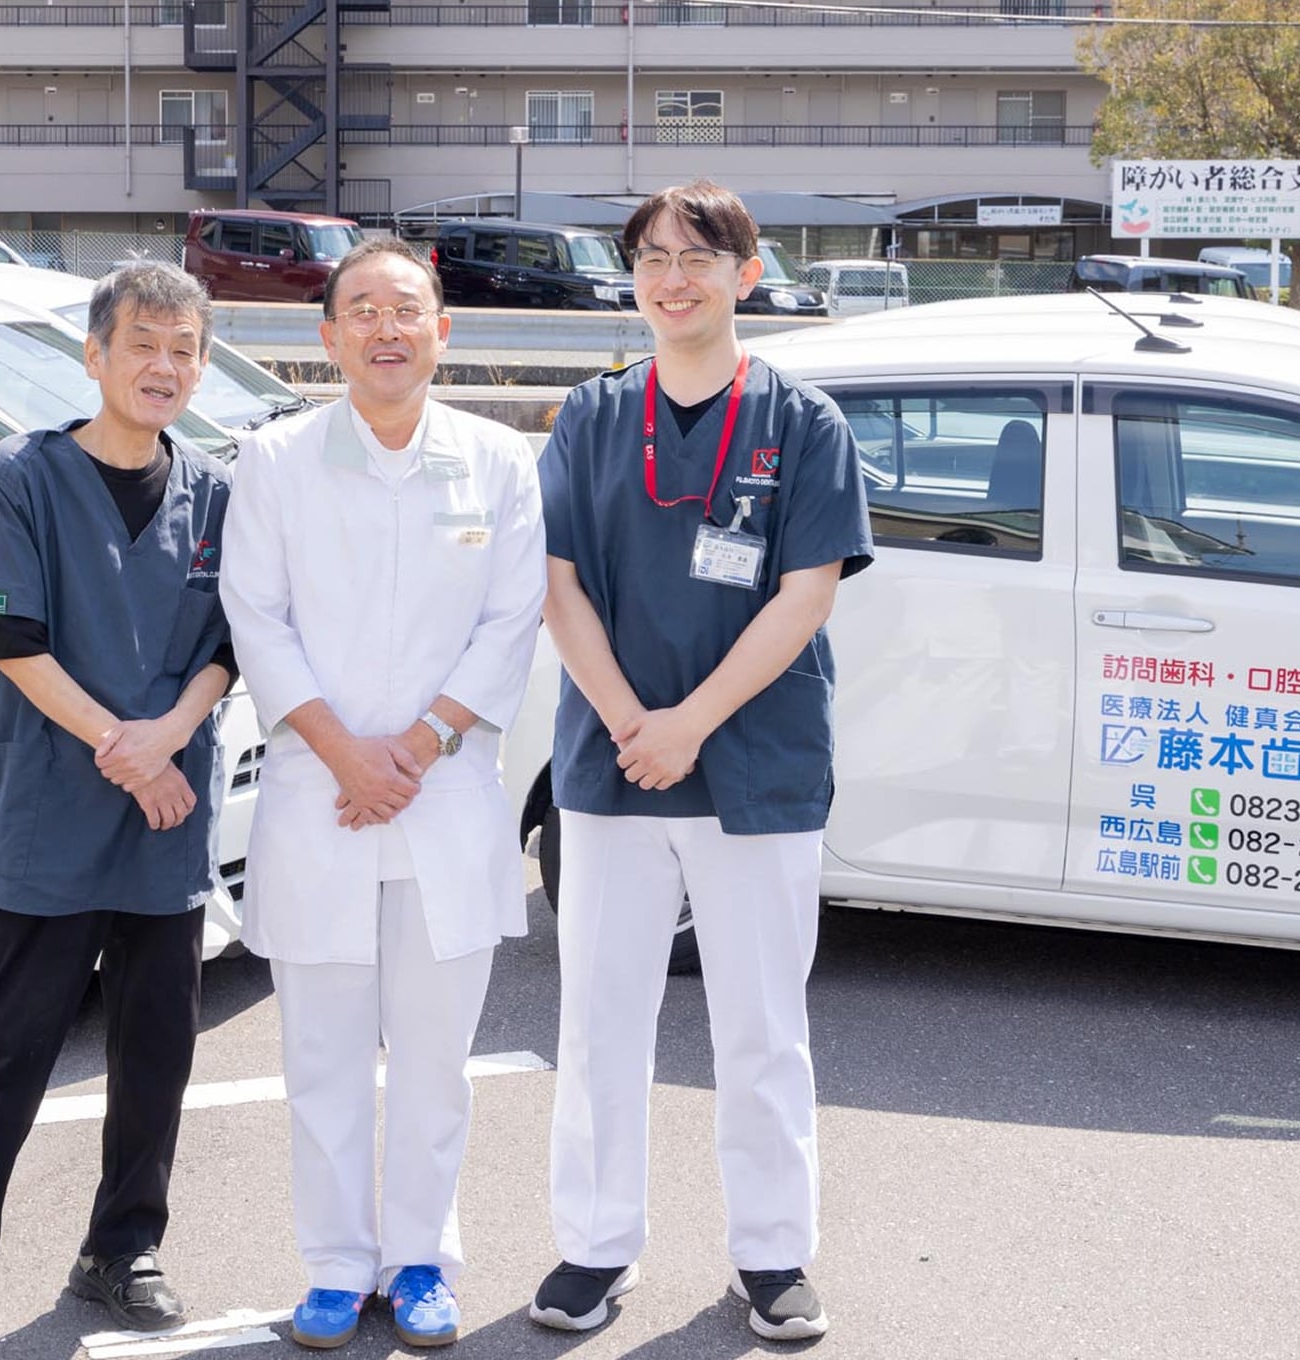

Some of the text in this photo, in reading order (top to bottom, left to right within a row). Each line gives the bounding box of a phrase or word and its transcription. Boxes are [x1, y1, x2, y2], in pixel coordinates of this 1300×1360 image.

[1103, 654, 1300, 695] 訪問歯科・口腔
[1101, 694, 1300, 733] 医療法人 健真会
[1157, 727, 1300, 782] 藤本歯
[1130, 784, 1300, 822] 呉 0823
[1100, 815, 1300, 856] 西広島 082-
[1096, 849, 1180, 881] 広島駅前
